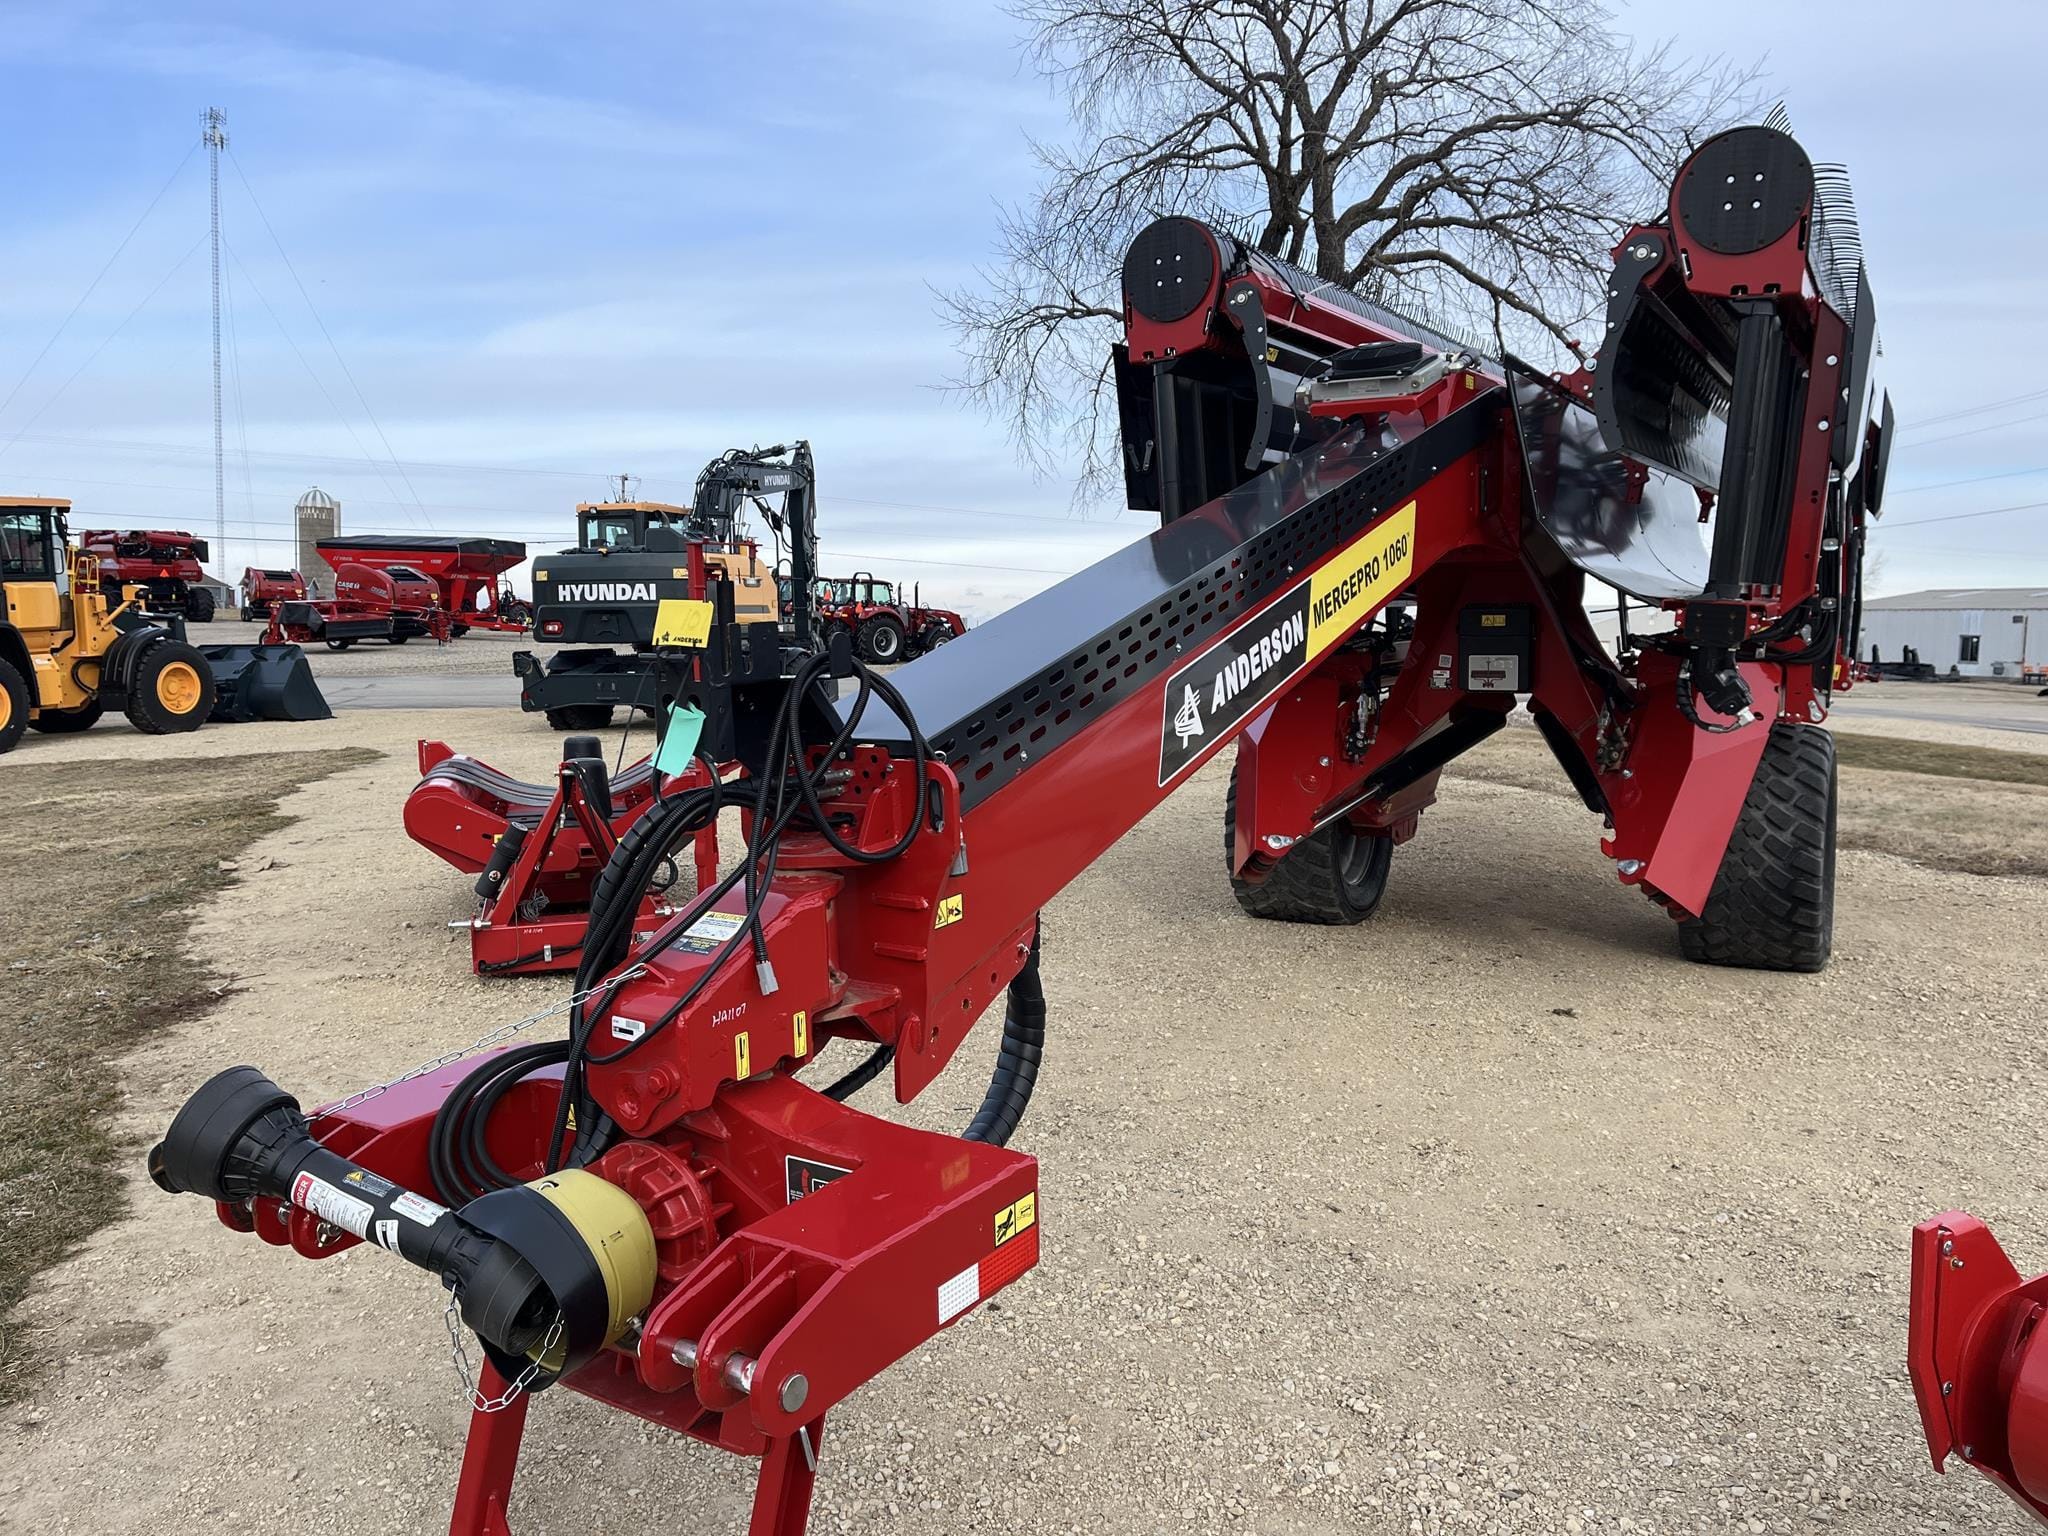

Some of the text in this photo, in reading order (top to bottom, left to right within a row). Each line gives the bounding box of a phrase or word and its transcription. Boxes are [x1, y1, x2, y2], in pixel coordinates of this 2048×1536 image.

[764, 474, 791, 486] HYUNDAI
[337, 581, 354, 589] CASE
[558, 583, 656, 601] HYUNDAI
[1313, 556, 1380, 629] MERGEPRO
[672, 636, 703, 644] ANDERSON
[1211, 610, 1304, 715] ANDERSON
[712, 1002, 747, 1028] HA1107
